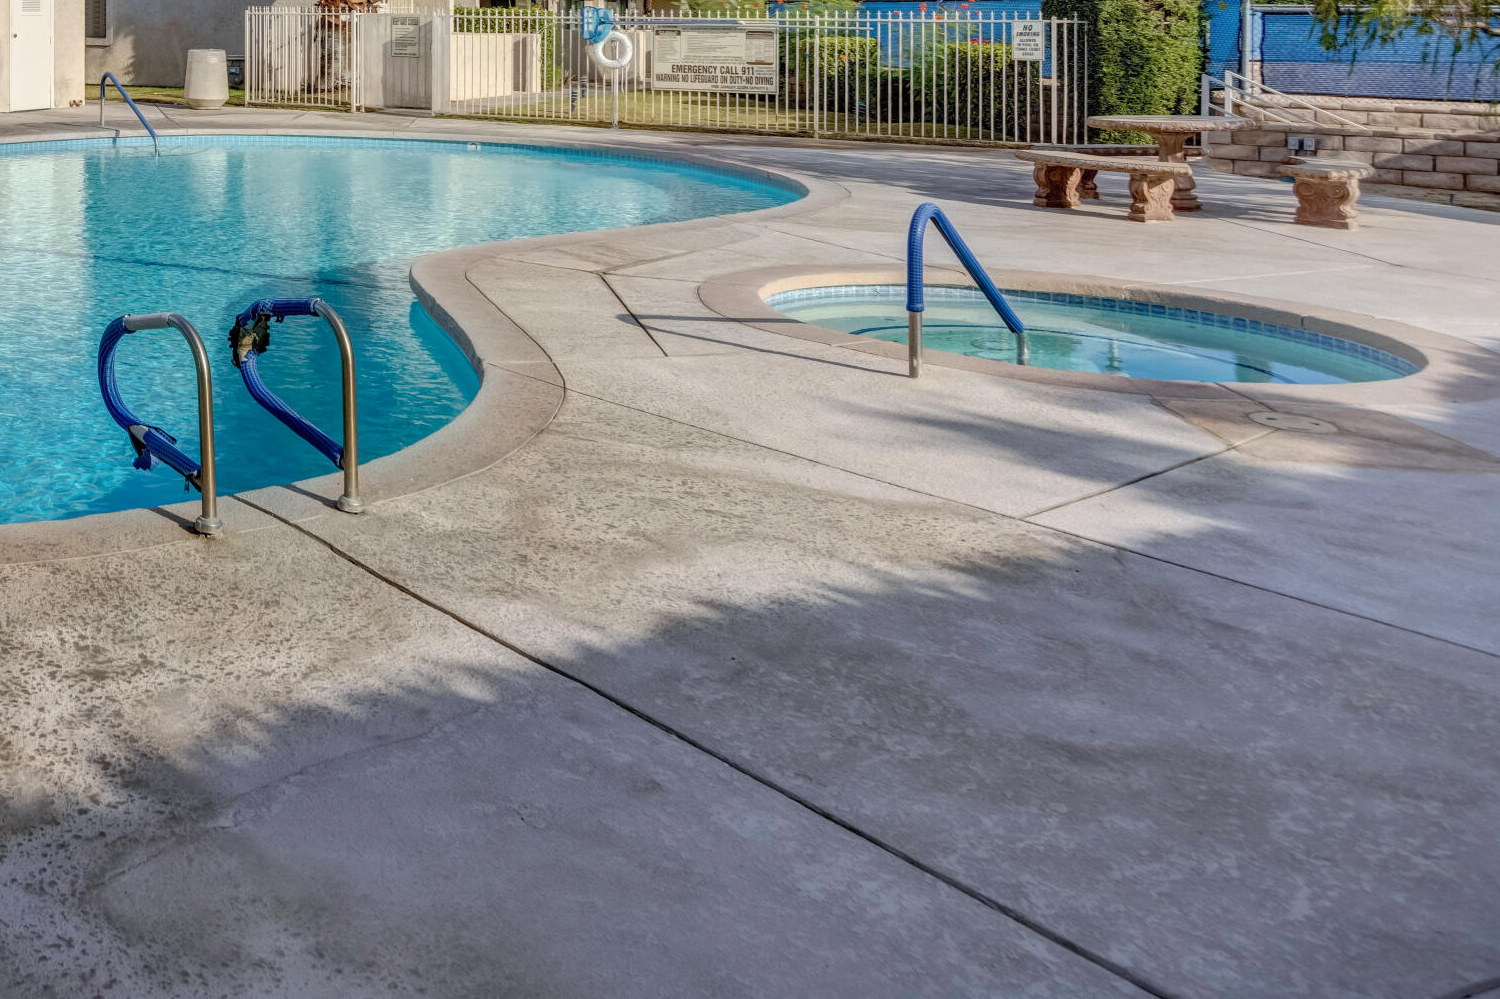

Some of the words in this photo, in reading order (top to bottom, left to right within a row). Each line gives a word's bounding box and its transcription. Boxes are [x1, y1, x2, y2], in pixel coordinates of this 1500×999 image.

[672, 65, 717, 74] EMERGENCY
[720, 66, 739, 75] CALL
[741, 66, 754, 75] 911
[656, 74, 680, 82] WARNING
[681, 74, 689, 82] NO
[690, 74, 718, 84] LIFEGUARD
[720, 75, 728, 84] ON
[755, 76, 773, 86] DIVING
